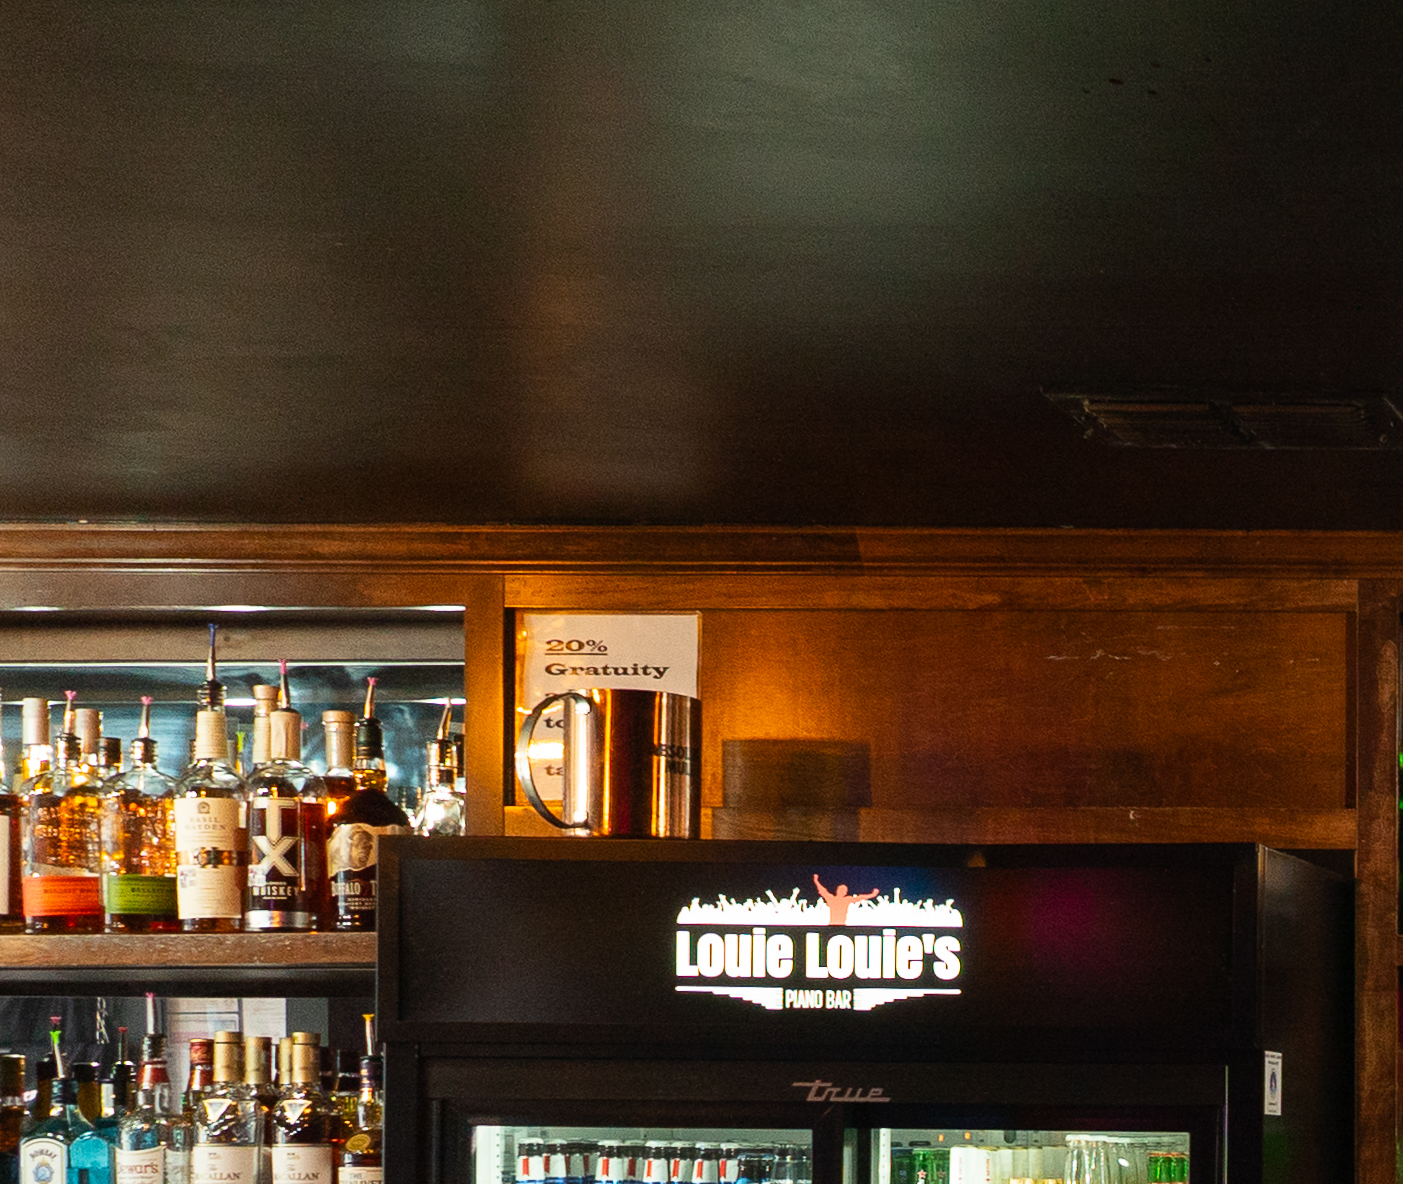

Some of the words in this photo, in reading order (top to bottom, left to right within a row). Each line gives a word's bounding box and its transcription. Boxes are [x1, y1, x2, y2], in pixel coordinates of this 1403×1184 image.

[545, 639, 608, 653] 20%
[545, 663, 669, 679] Gratuity
[251, 885, 299, 897] WHISKEY
[676, 927, 795, 979] Louie
[806, 928, 961, 980] Louie's
[785, 989, 823, 1009] PIANO
[826, 989, 852, 1010] BAR
